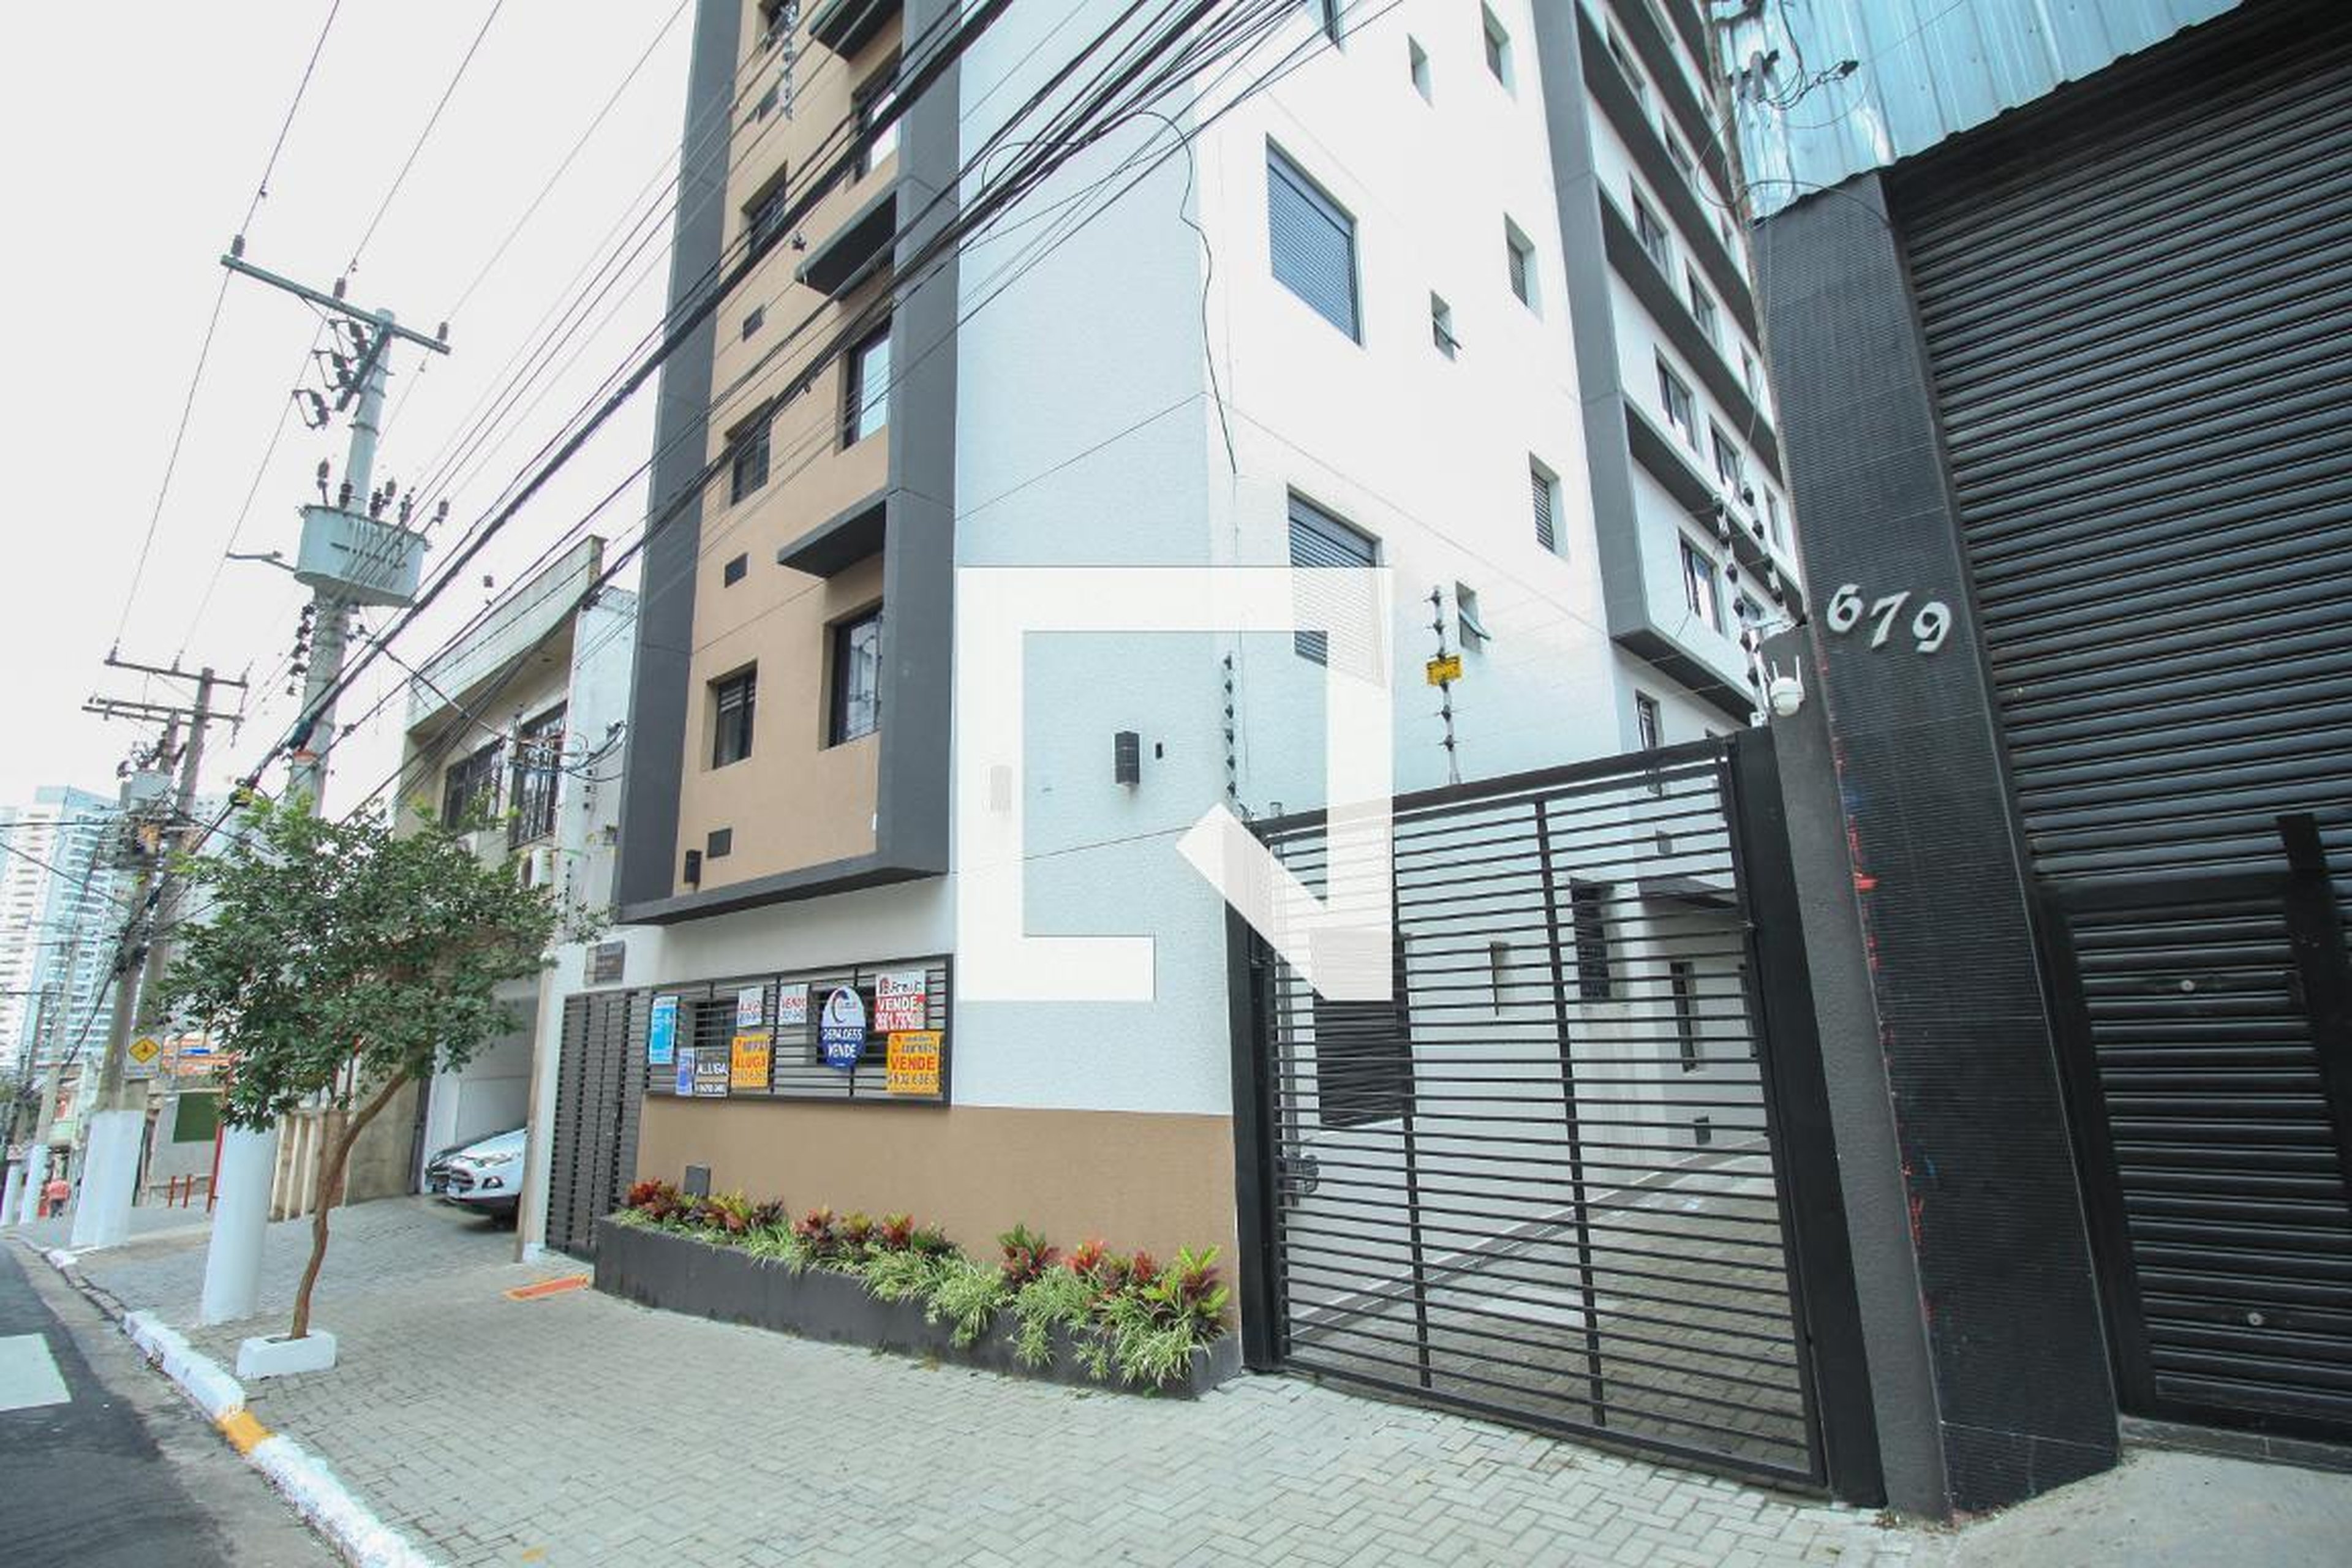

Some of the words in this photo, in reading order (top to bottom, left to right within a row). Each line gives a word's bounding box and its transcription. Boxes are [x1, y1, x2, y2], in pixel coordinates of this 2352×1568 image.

[1827, 583, 1951, 653] 679
[876, 995, 918, 1012] VENDE
[827, 1042, 857, 1058] VENDE
[697, 1062, 728, 1076] ALUGA
[891, 1056, 935, 1071] VENDE
